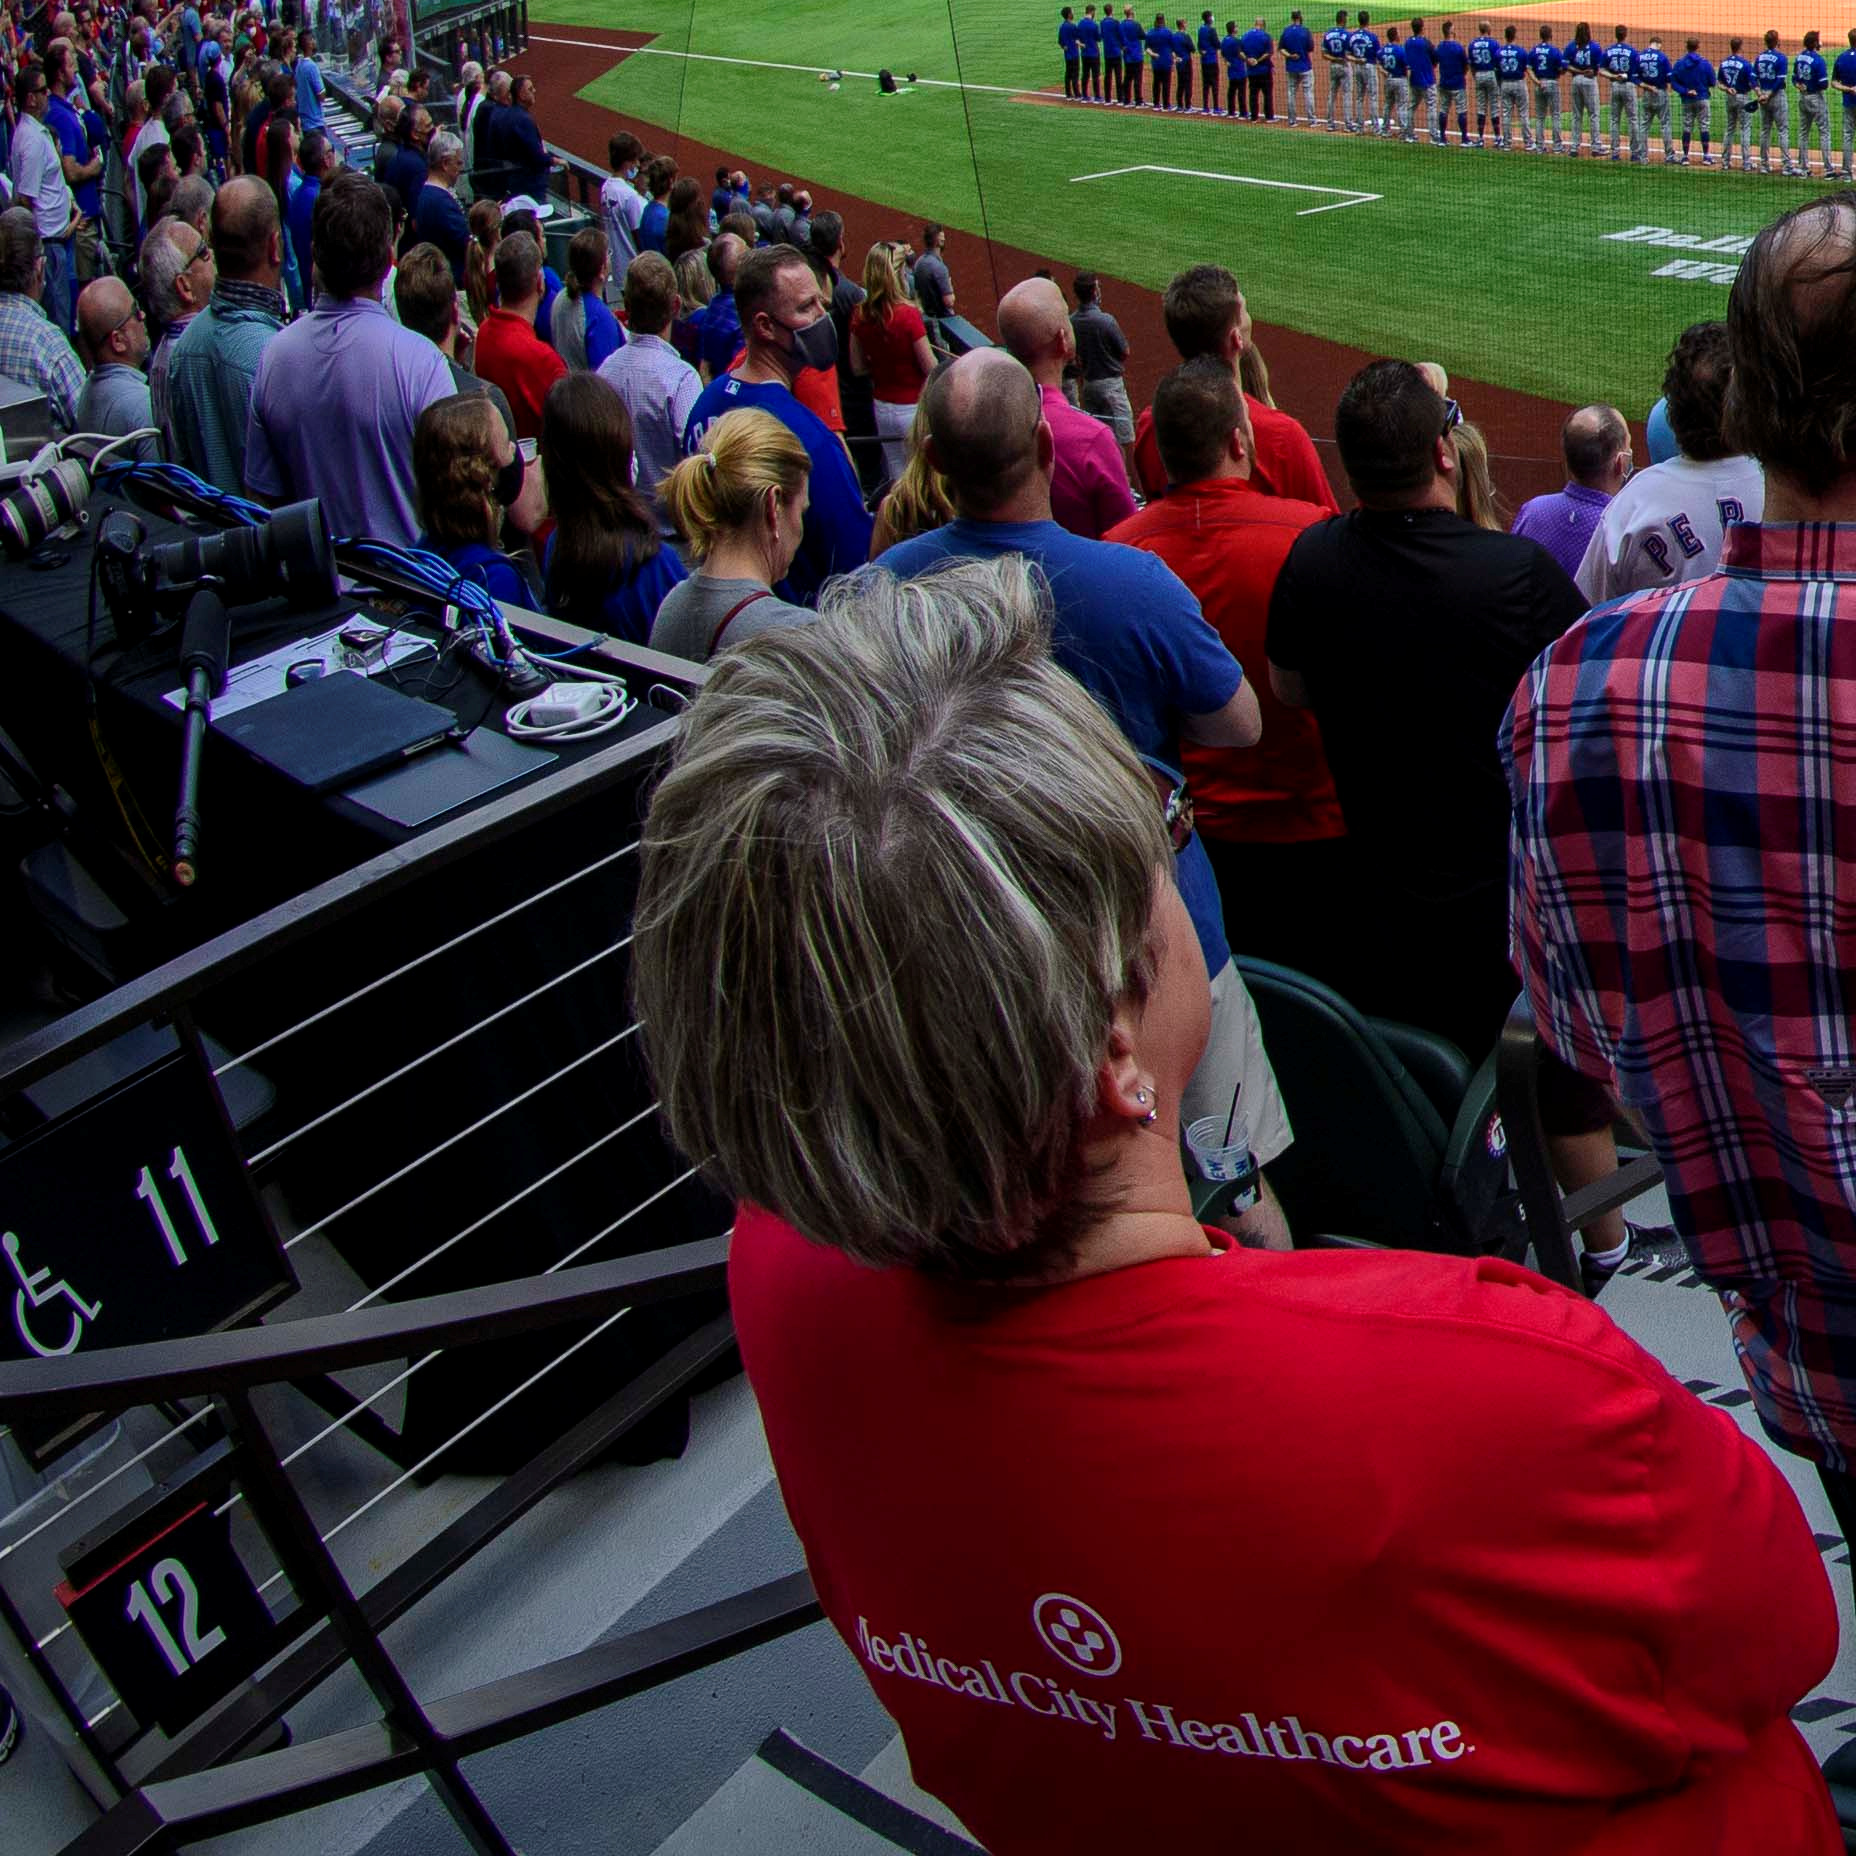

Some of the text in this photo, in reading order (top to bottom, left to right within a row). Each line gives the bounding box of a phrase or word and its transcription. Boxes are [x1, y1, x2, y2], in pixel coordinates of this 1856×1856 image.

[135, 1144, 220, 1266] 11
[125, 1557, 228, 1677] 12
[856, 1614, 1014, 1707] Medical
[1013, 1667, 1119, 1742] City
